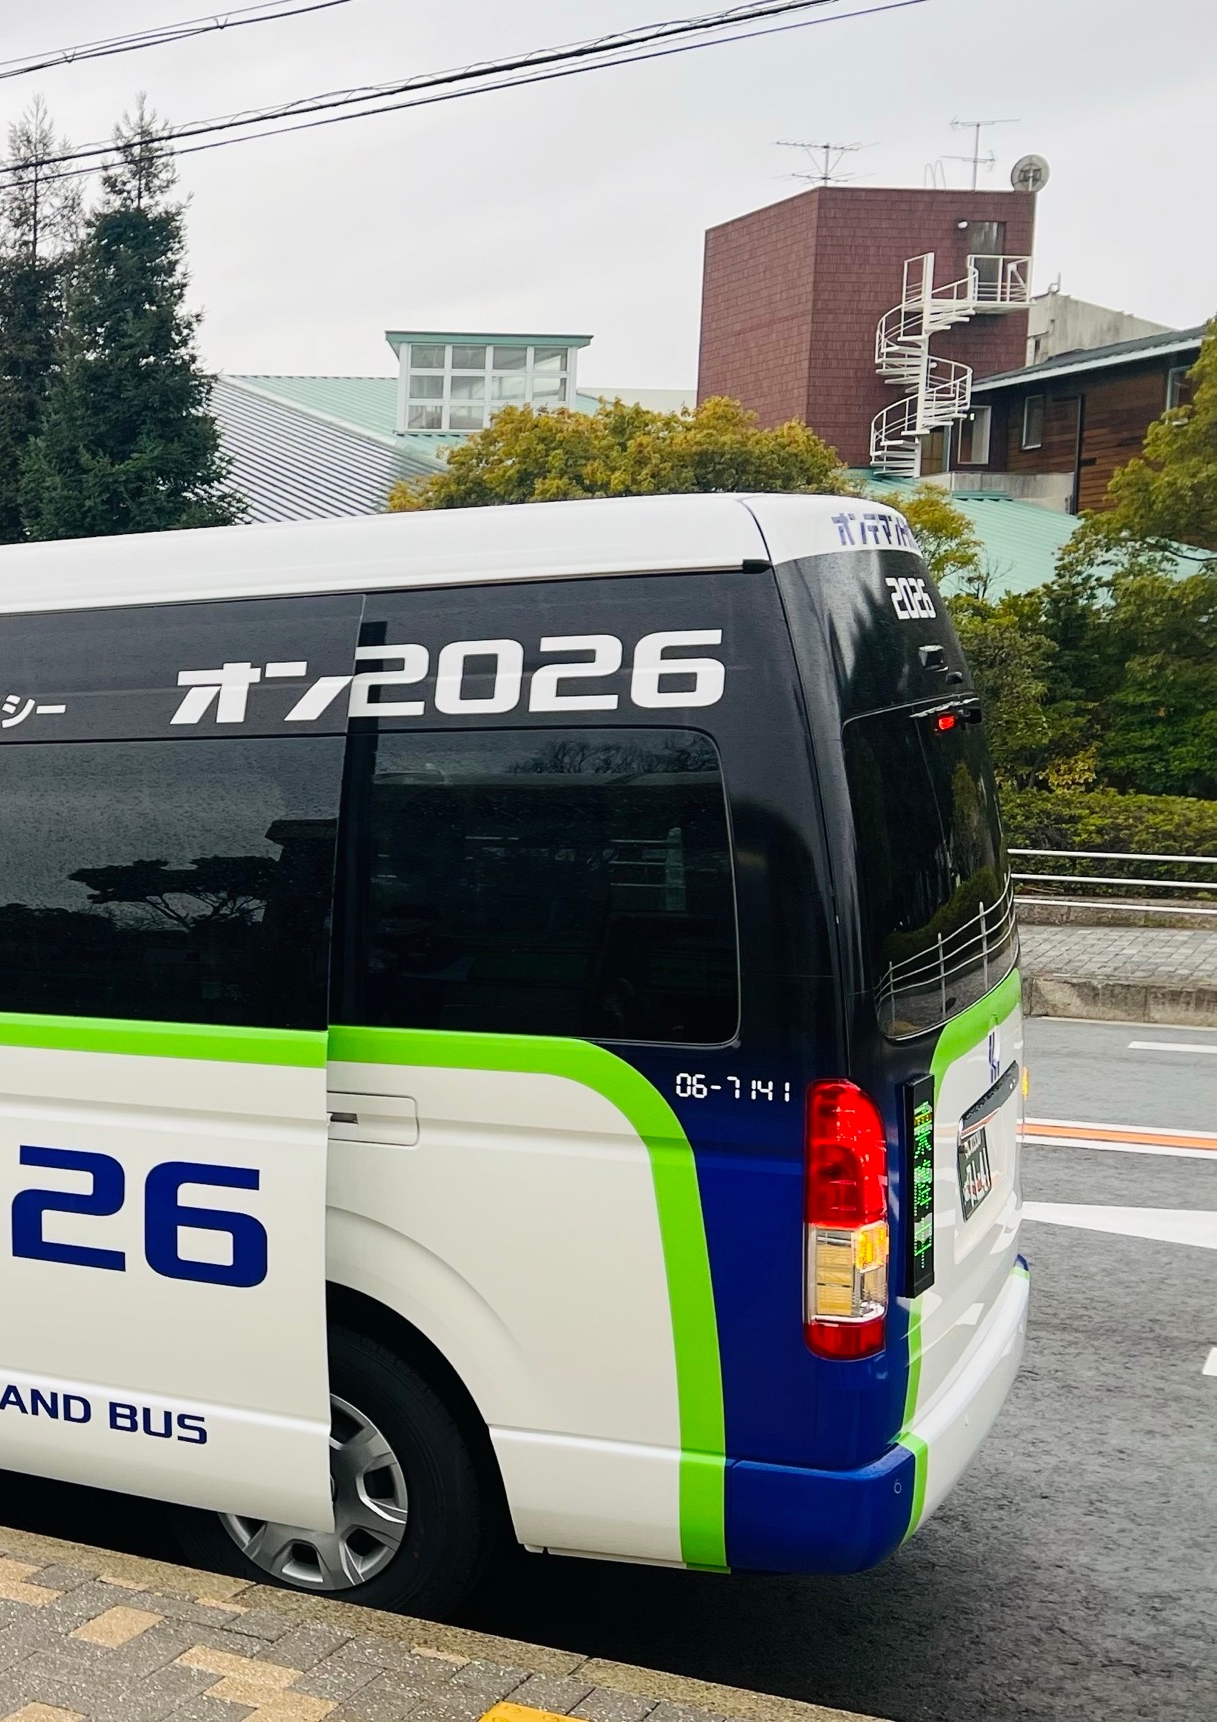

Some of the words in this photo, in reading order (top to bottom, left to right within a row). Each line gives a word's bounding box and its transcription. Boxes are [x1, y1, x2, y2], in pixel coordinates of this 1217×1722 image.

[885, 576, 937, 620] 2026
[348, 629, 726, 717] 2026
[675, 1072, 790, 1102] 06-7141
[109, 1400, 208, 1445] BUS
